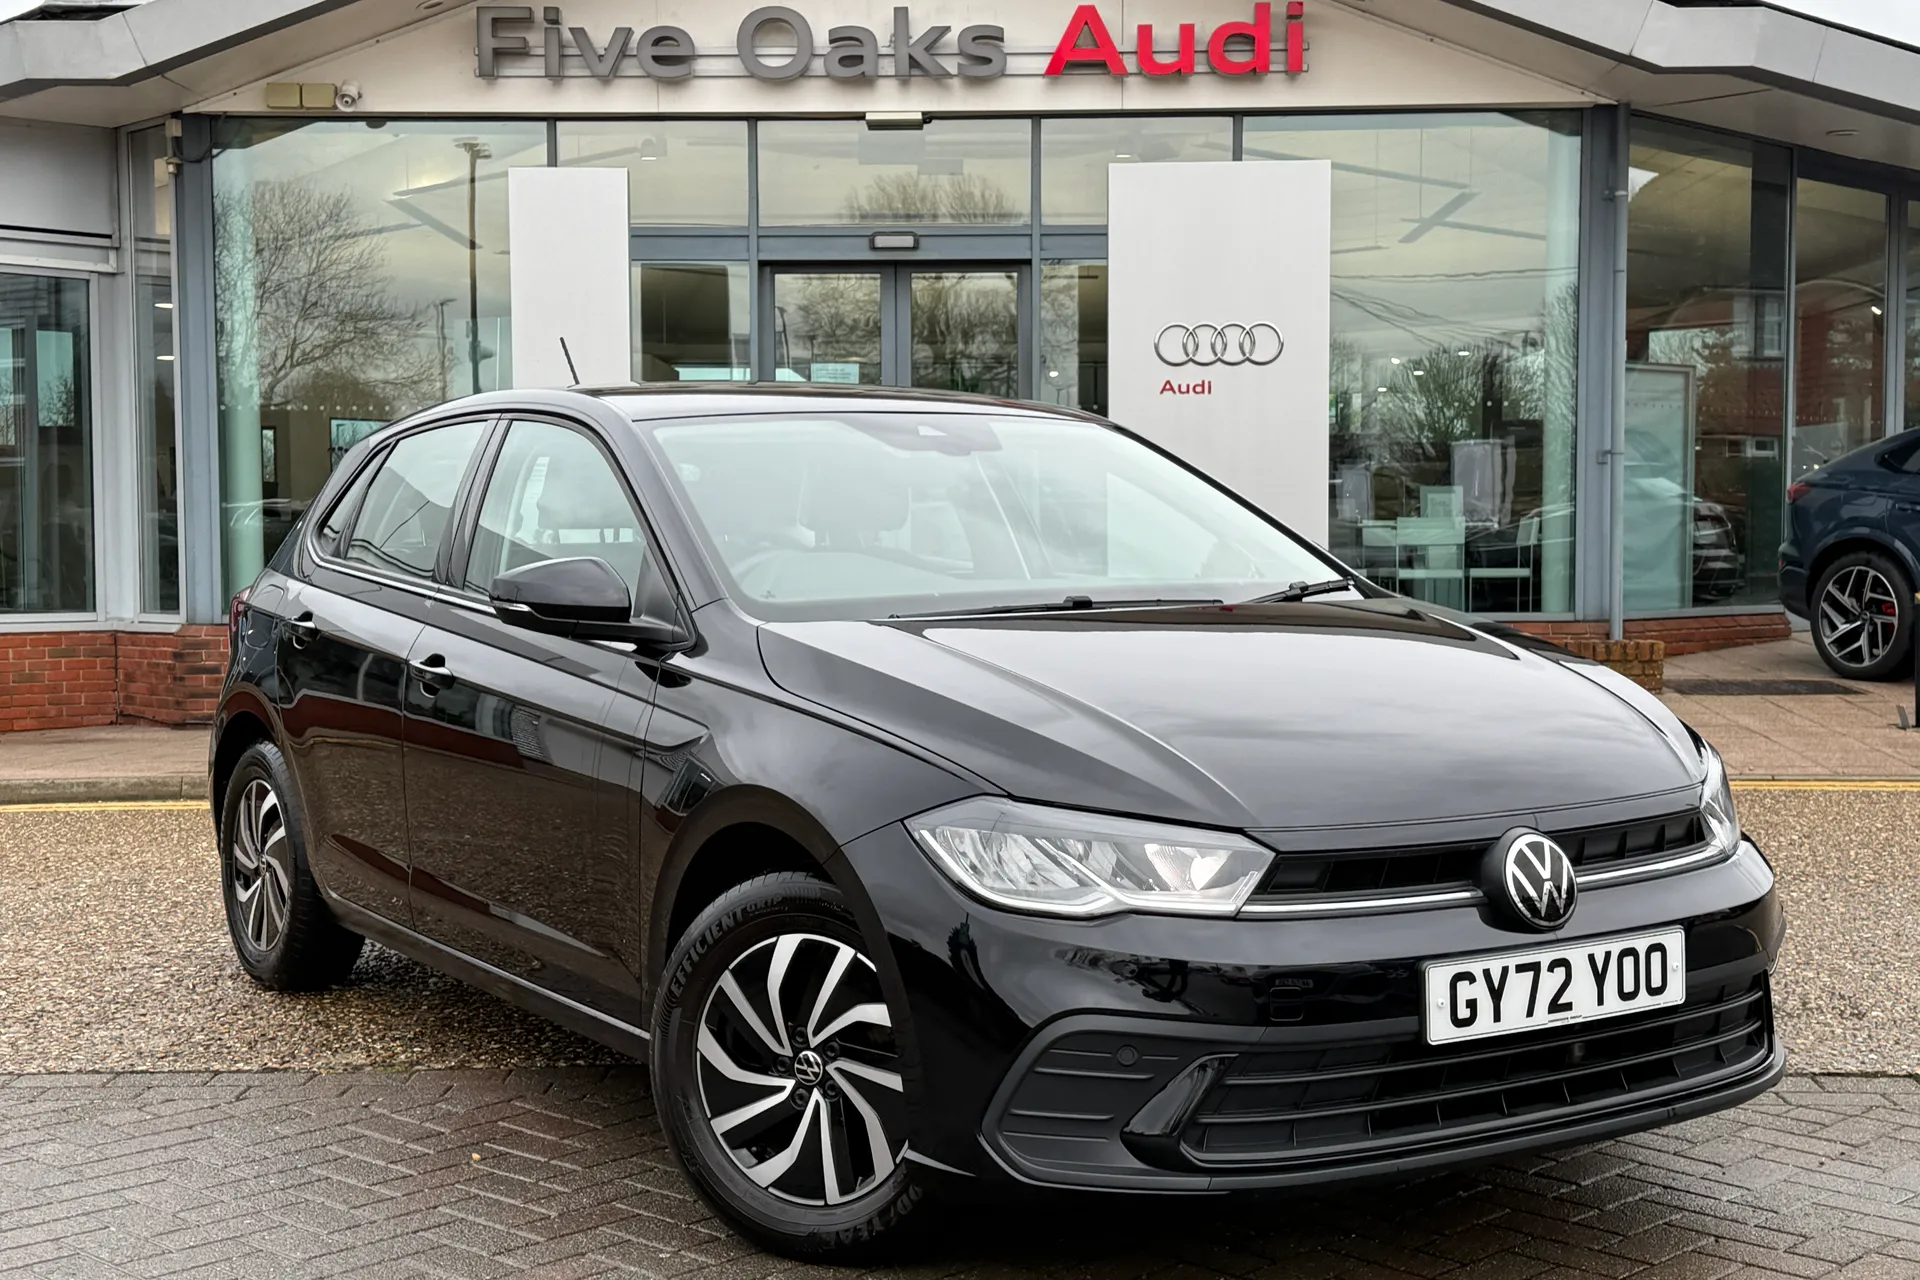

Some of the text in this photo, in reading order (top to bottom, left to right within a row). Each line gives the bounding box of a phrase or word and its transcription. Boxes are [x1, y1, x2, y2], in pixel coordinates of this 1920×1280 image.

[477, 1, 1304, 80] Five Oaks Audi
[1160, 379, 1212, 395] Audi
[670, 905, 747, 998] EFFICIENT
[1450, 942, 1668, 1028] GY72 YOO
